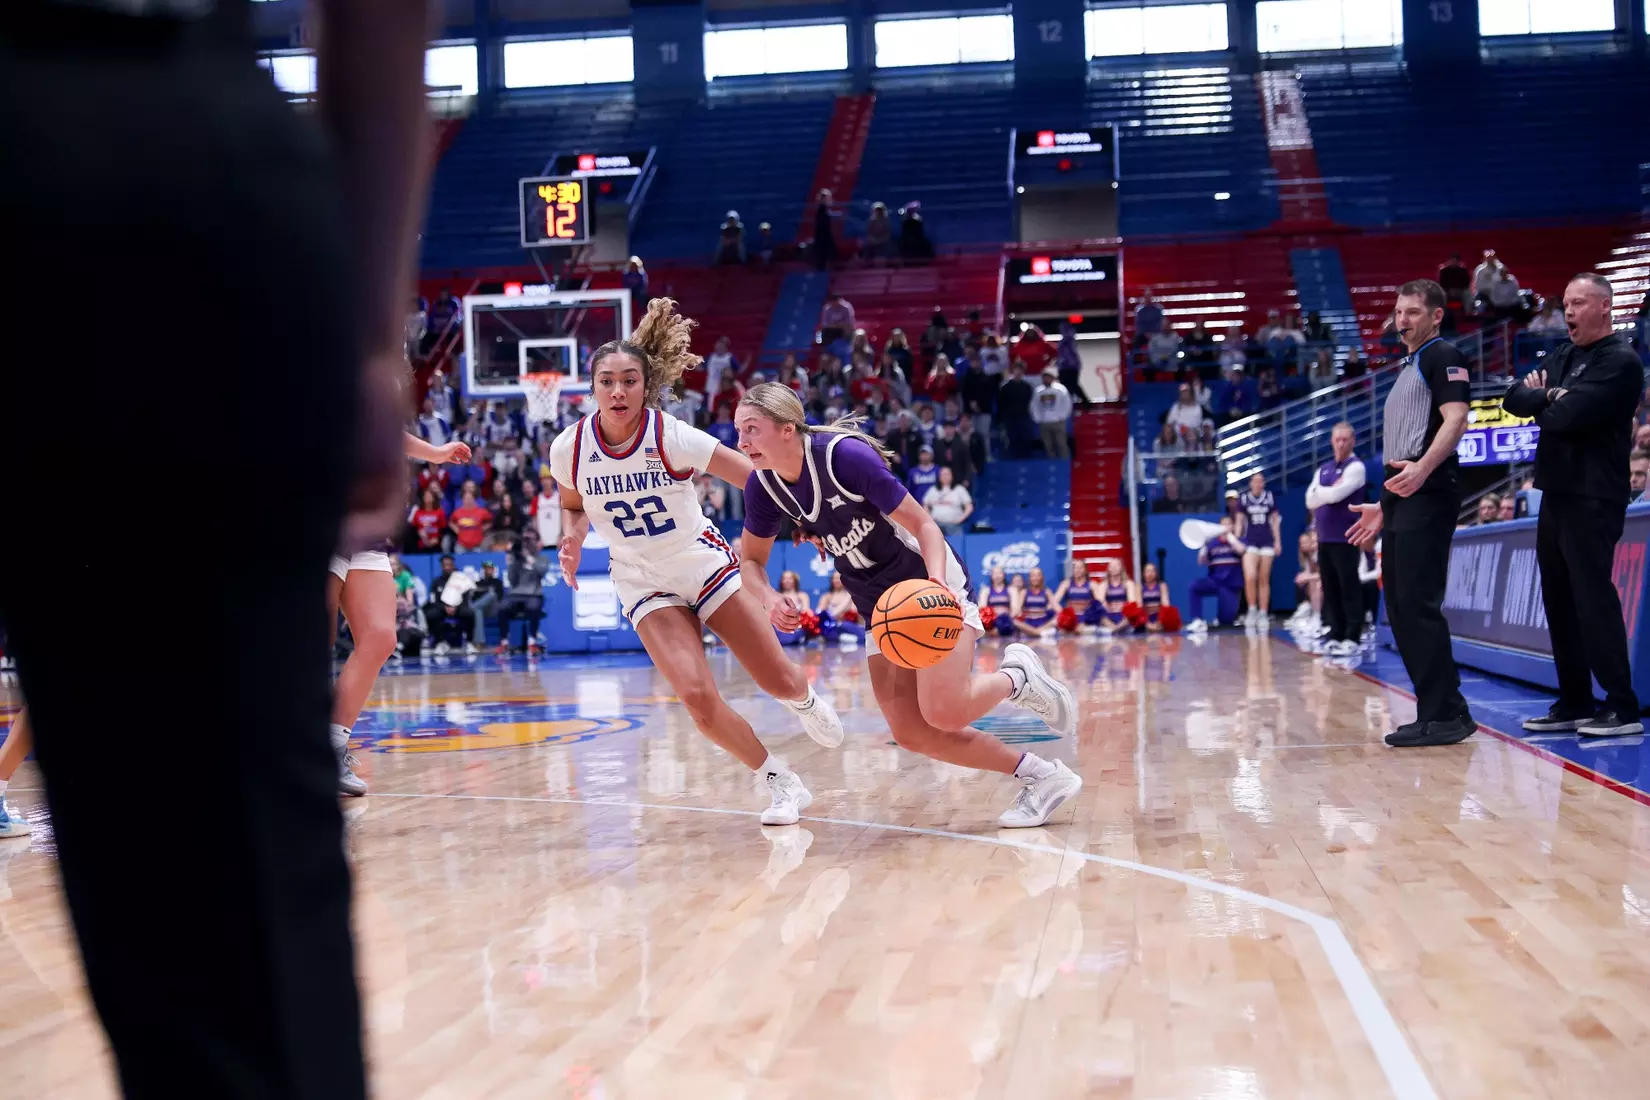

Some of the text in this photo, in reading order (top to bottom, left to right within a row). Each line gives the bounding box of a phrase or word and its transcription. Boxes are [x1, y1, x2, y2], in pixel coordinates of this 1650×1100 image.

[1038, 20, 1063, 43] 12
[539, 182, 581, 203] 4:30
[546, 203, 576, 238] 12
[586, 472, 673, 495] JAYHAWKS
[604, 495, 677, 538] 22
